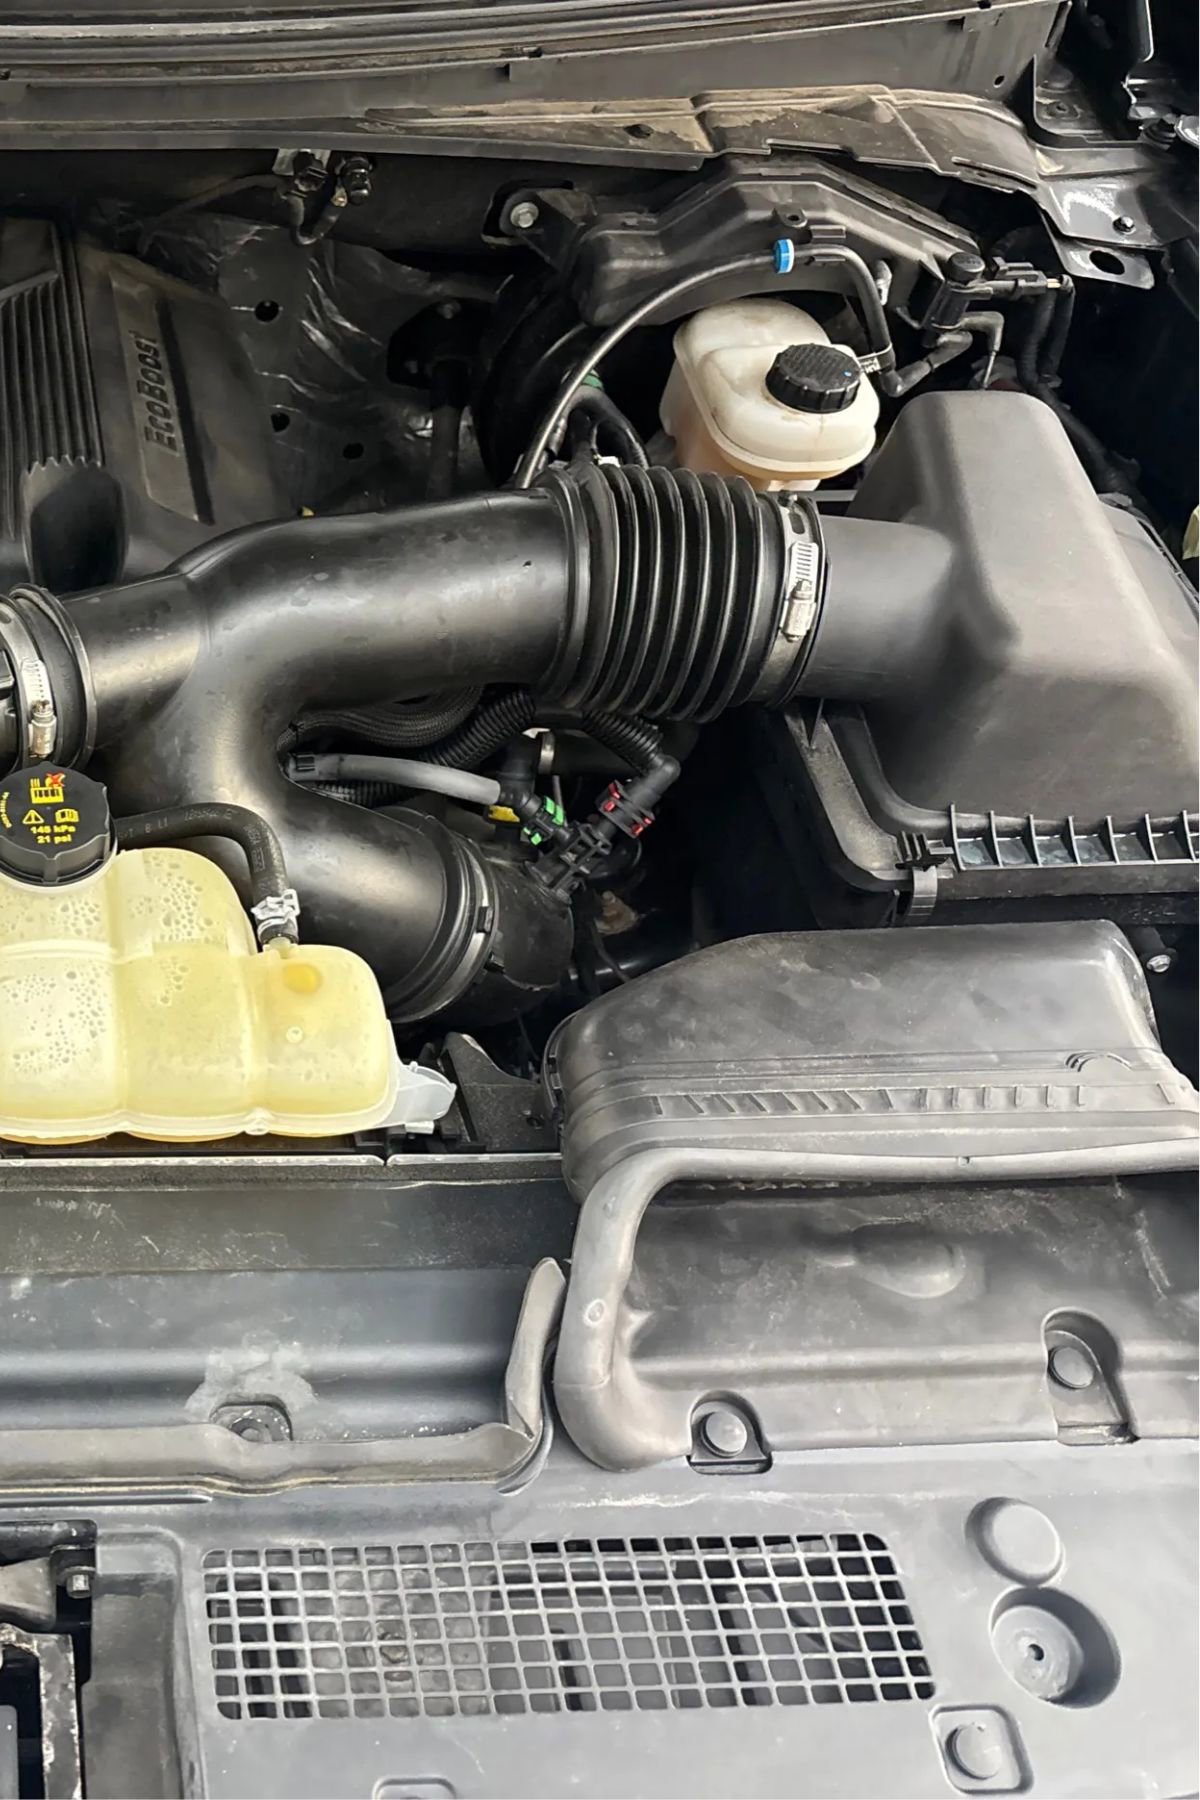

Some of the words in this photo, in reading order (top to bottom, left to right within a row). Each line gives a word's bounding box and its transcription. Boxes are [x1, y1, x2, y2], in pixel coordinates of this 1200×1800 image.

[128, 329, 179, 453] EcoBoost
[36, 835, 50, 844] 21
[54, 834, 72, 845] psi
